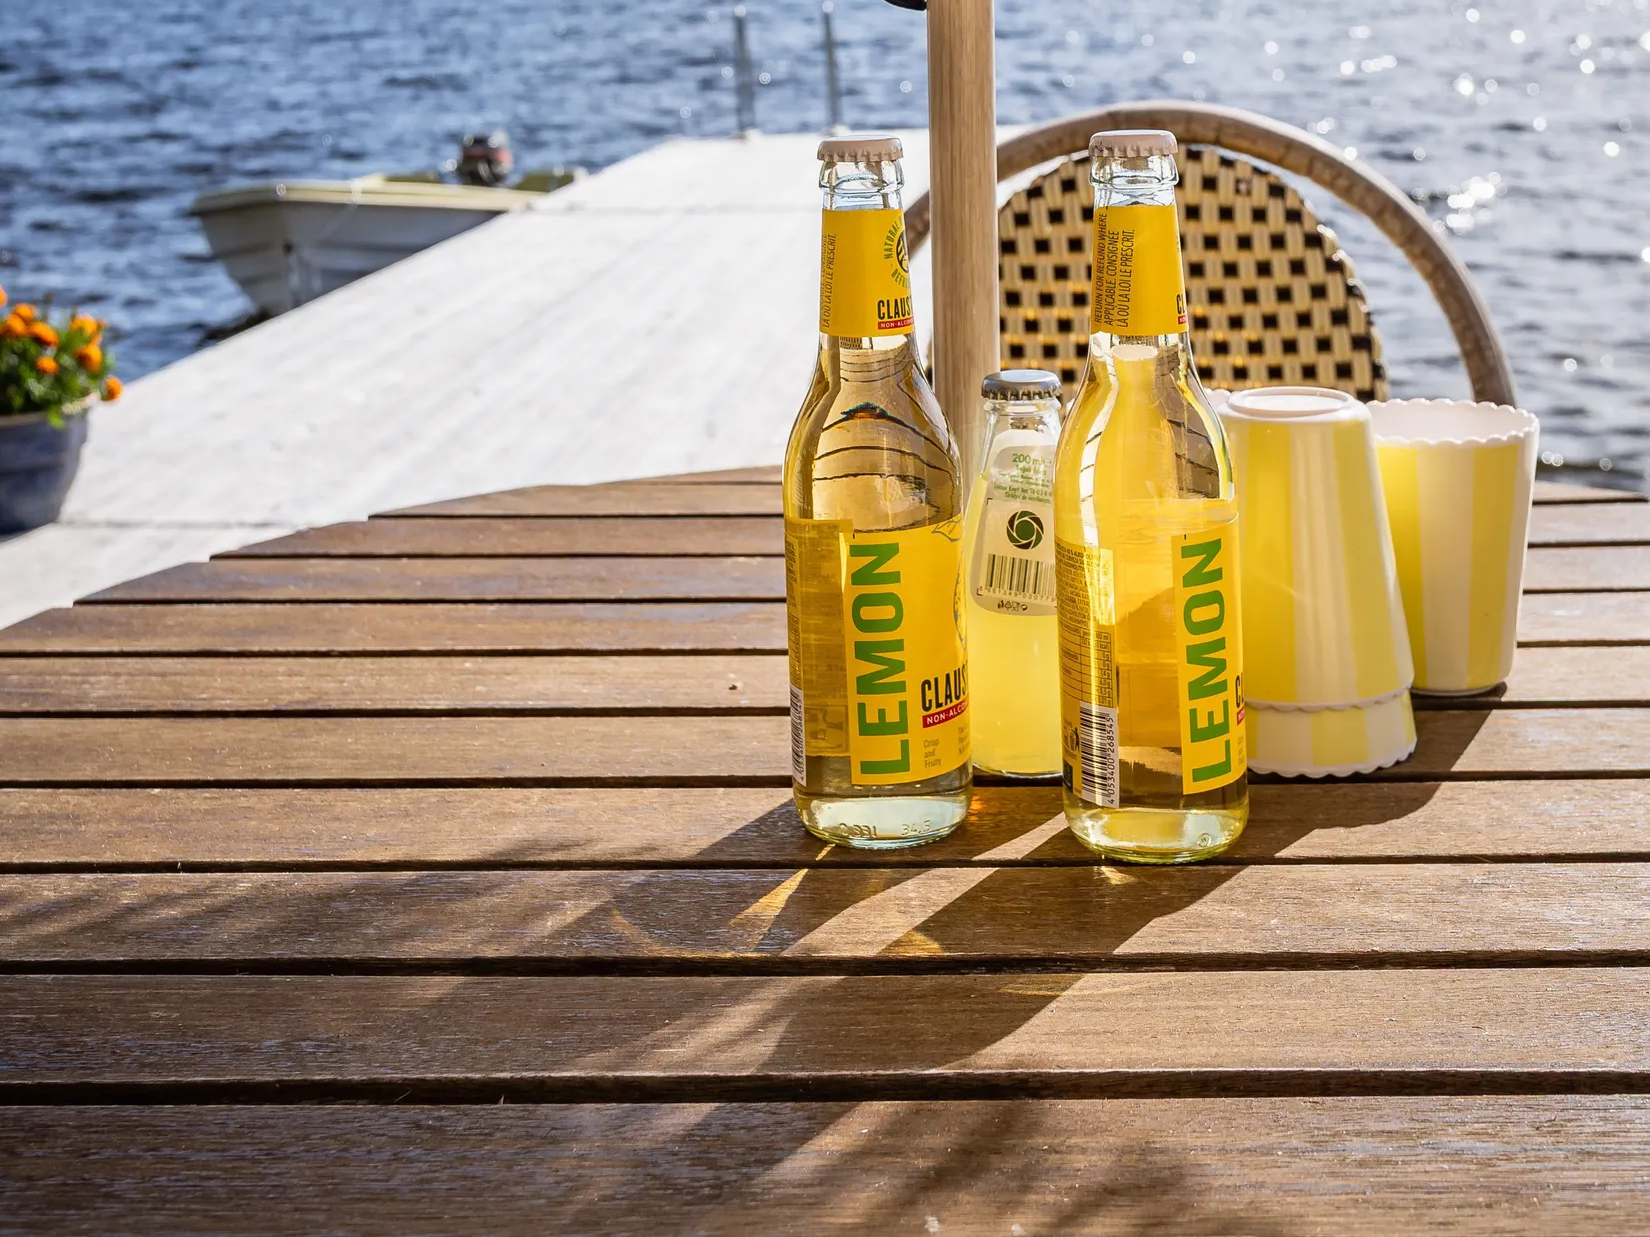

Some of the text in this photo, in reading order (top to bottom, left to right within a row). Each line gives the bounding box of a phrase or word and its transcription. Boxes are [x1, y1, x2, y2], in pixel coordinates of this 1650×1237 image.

[1121, 229, 1135, 268] PRESCRIT.
[1095, 212, 1108, 324] RETURN FOR REFUND WHERE
[1105, 230, 1120, 326] APPLICABLE. CONSIGNÉE
[1119, 278, 1132, 292] LOI
[1120, 269, 1132, 278] LE
[1118, 293, 1131, 303] LA
[1012, 452, 1032, 465] 200
[849, 541, 911, 776] LEMON
[1180, 537, 1232, 783] LEMON
[923, 738, 940, 749] Crisp
[924, 749, 936, 759] and
[1106, 717, 1115, 754] 268545
[1107, 757, 1116, 796] 053400
